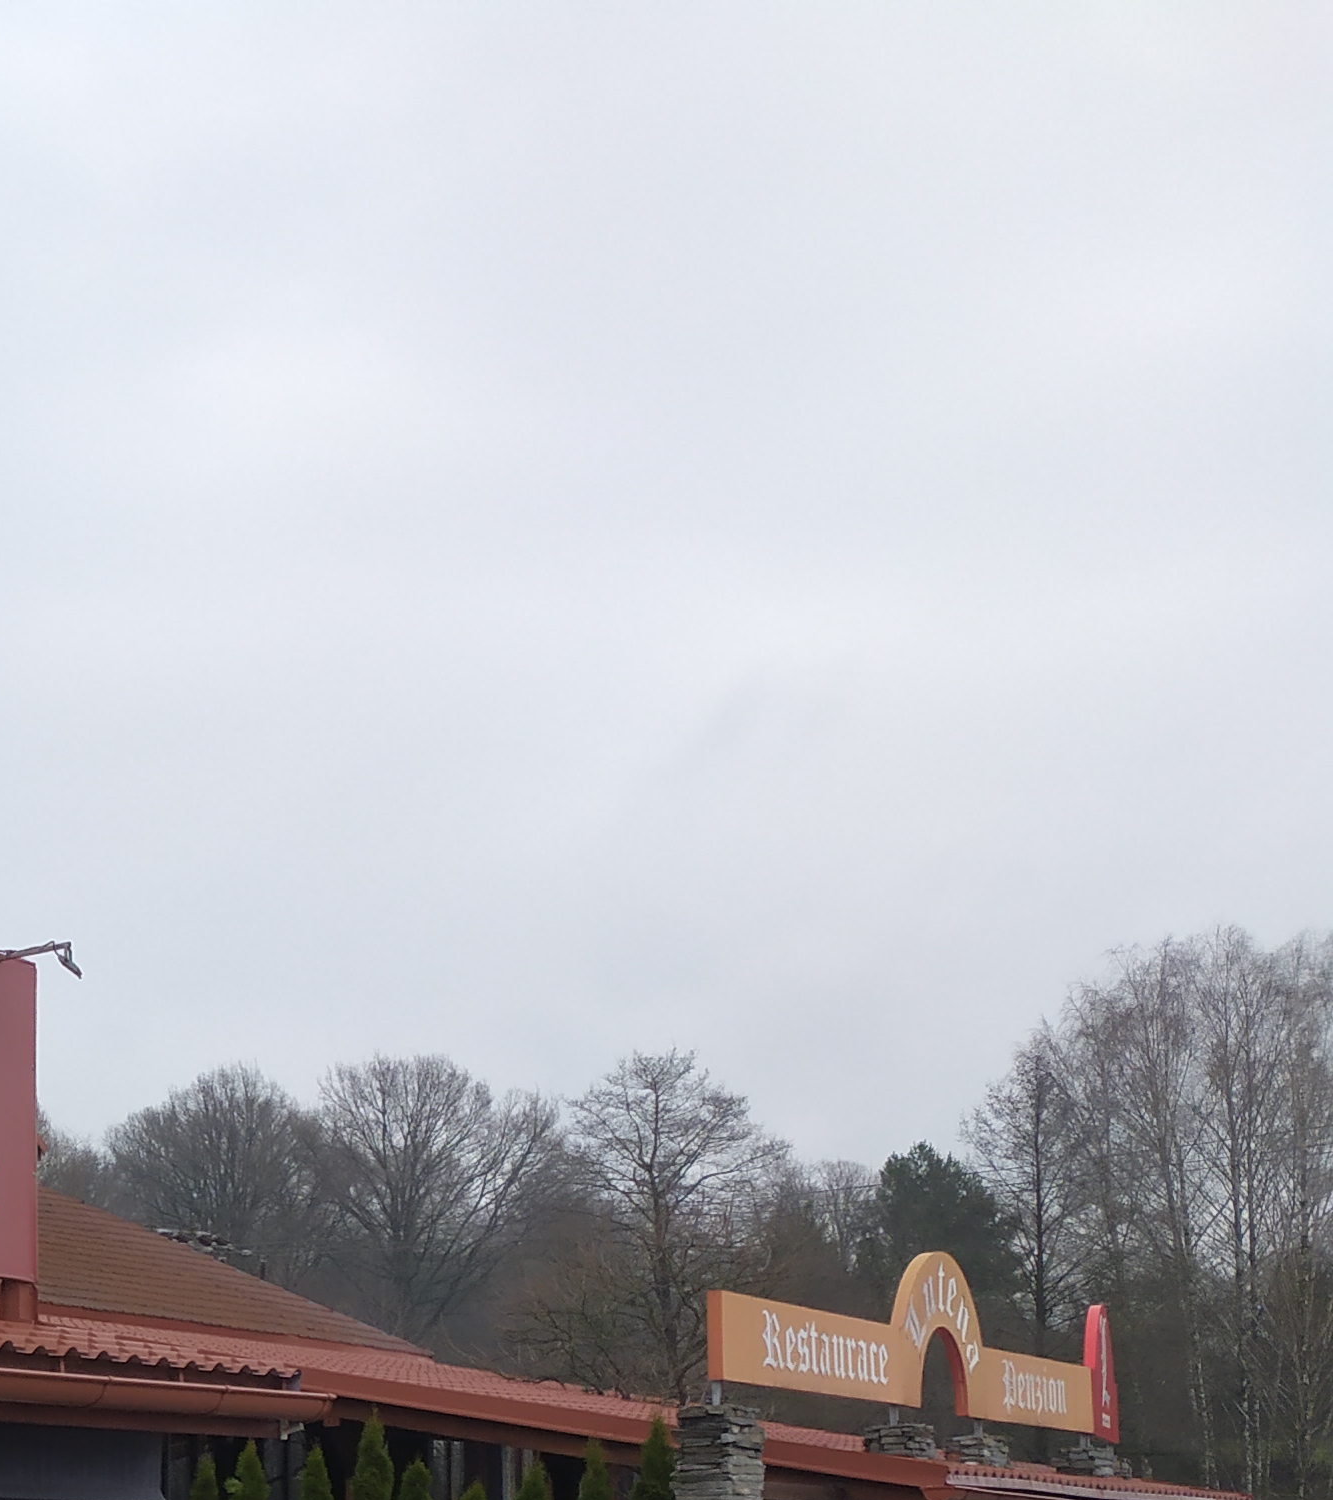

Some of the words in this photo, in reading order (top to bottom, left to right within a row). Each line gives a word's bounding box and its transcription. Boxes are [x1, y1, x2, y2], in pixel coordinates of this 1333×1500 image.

[762, 1308, 889, 1386] Restaurace
[1002, 1359, 1068, 1424] Penzion
[904, 1261, 981, 1375] Lutena
